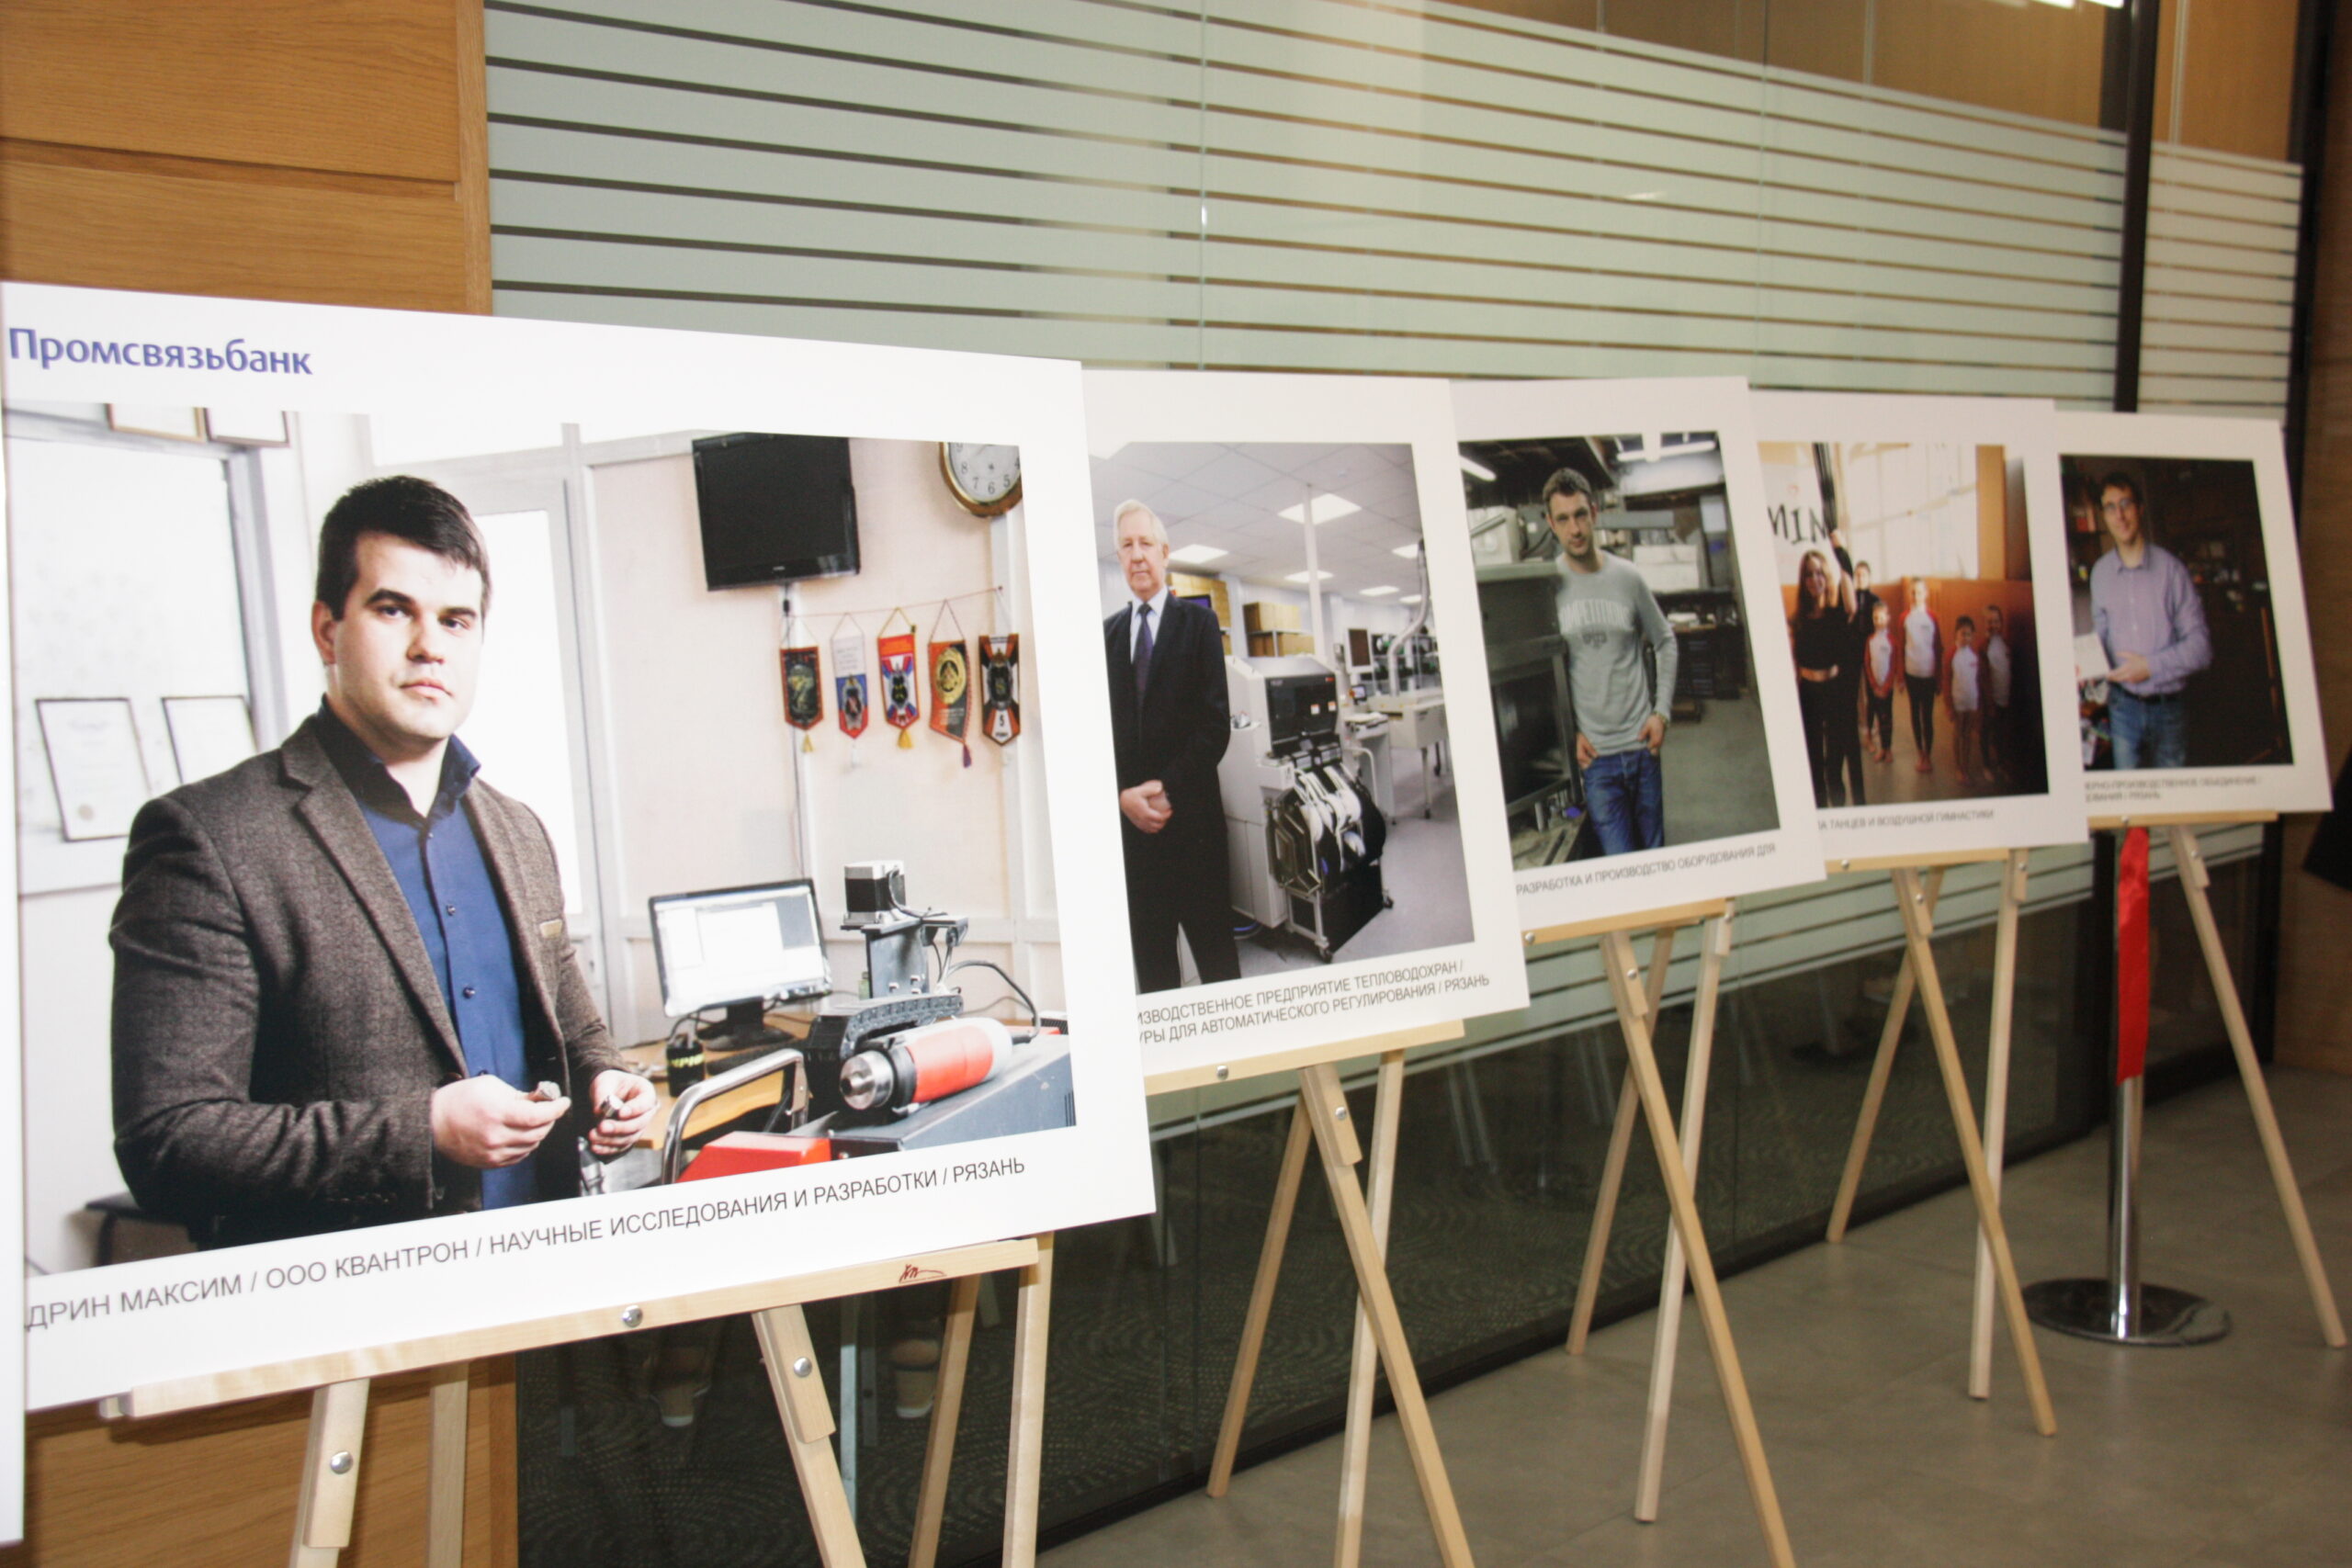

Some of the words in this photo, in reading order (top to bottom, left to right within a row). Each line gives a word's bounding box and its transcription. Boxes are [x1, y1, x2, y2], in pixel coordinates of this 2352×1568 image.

[8, 327, 313, 376] Промсвязьбанк
[1830, 817, 1866, 829] ТАНЦЕВ
[1877, 811, 1935, 826] ВОЗДУШНОЙ
[1936, 808, 1994, 821] ГИМНАСТИКИ
[1516, 875, 1583, 897] РАЗРАБОТКА
[1585, 874, 1593, 885] И
[1595, 859, 1676, 882] ПРОИЗВОДСТВО
[1677, 846, 1754, 869] ОБОРУДОВАНИЯ
[1757, 842, 1775, 858] ДЛЯ
[1169, 1022, 1197, 1043] ДЛЯ
[1201, 1000, 1329, 1034] АВТОМАТИЧЕСКОГО
[1332, 983, 1436, 1012] РЕГУЛИРОВАНИЯ
[1444, 974, 1490, 993] РЯЗАНЬ
[1256, 976, 1351, 1006] ПРЕДПРИЯТИЕ
[1353, 961, 1457, 989] ТЕПЛОВОДОХРАН
[24, 1293, 111, 1333] ДРИН
[120, 1273, 243, 1313] МАКСИМ
[250, 1270, 258, 1292] /
[265, 1260, 327, 1289] ООО
[334, 1238, 469, 1279] КВАНТРОН
[475, 1236, 482, 1258] /
[489, 1219, 604, 1256] НАУЧНЫЕ
[609, 1191, 788, 1236] ИССЛЕДОВАНИЯ
[794, 1189, 808, 1208] И
[813, 1169, 937, 1205] РАЗРАБОТКИ
[942, 1167, 947, 1185] /
[952, 1156, 1025, 1184] РЯЗАНЬ
